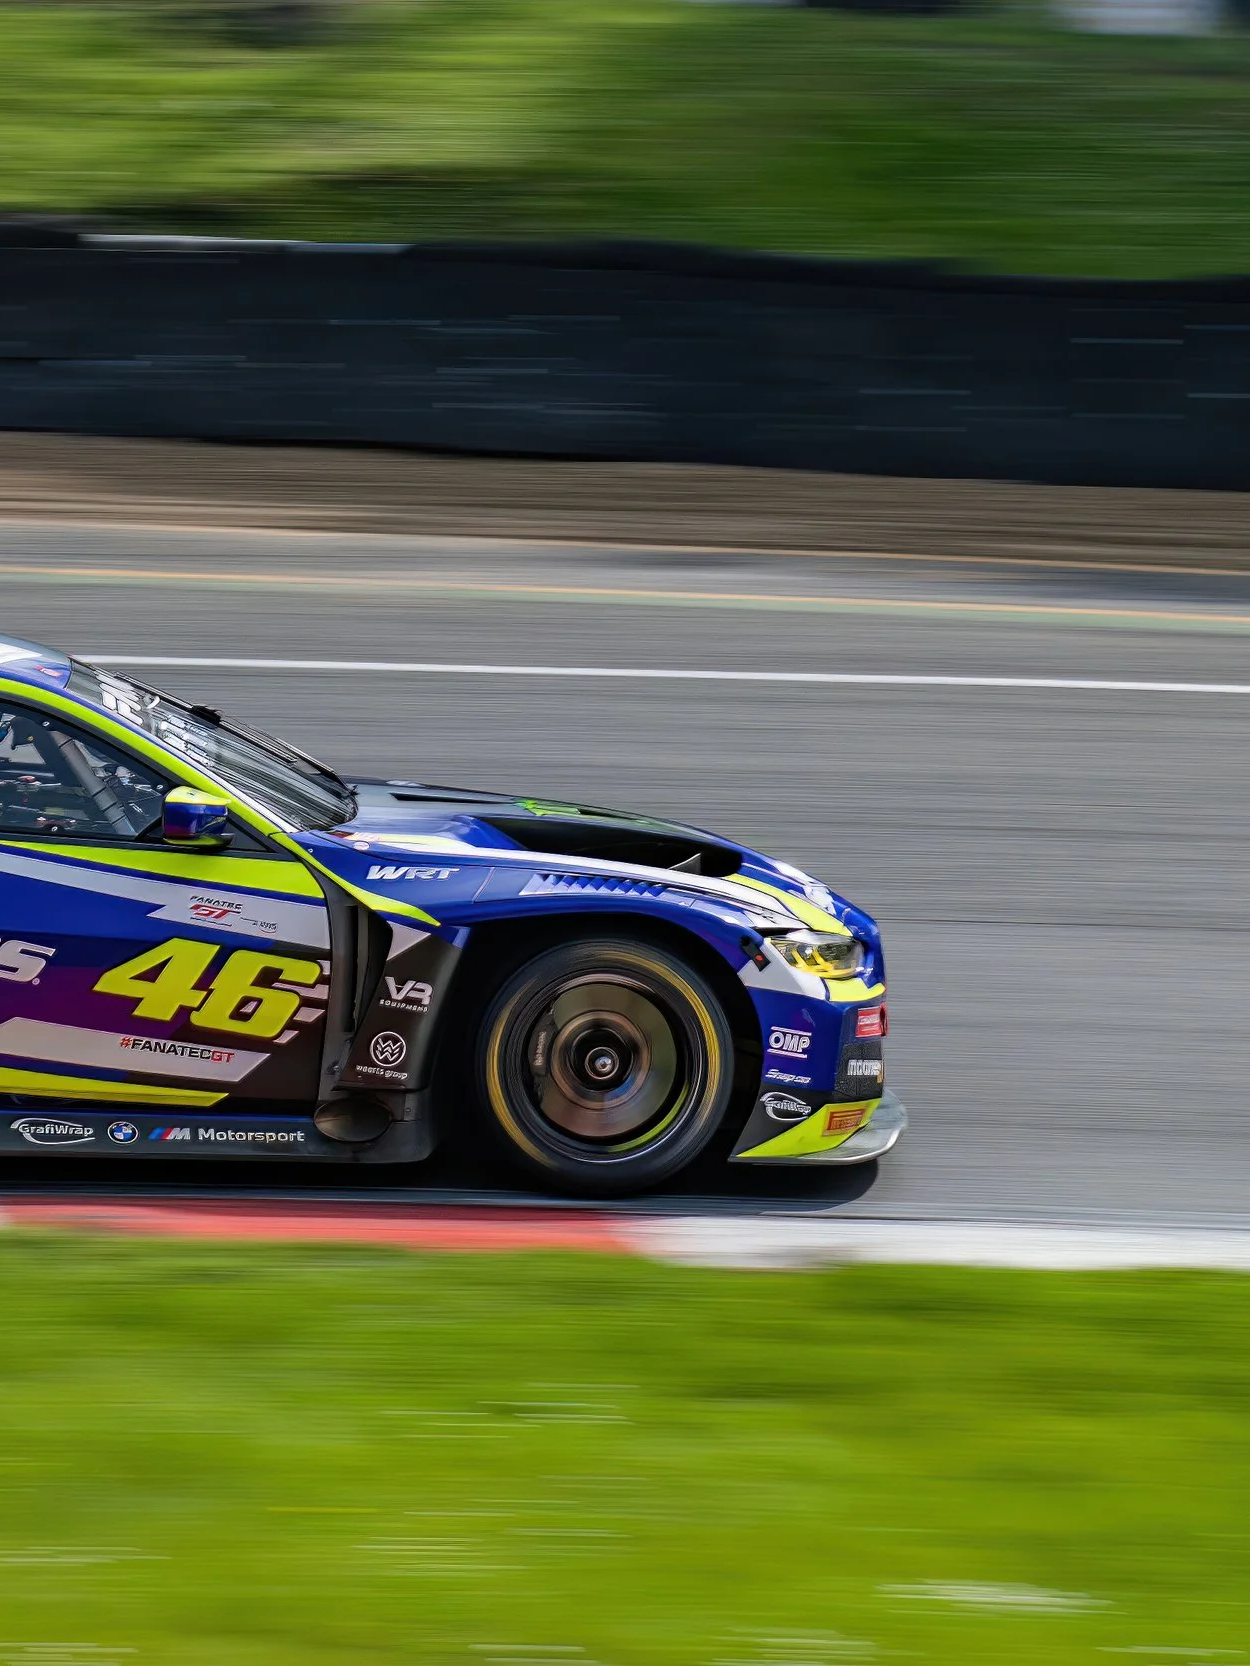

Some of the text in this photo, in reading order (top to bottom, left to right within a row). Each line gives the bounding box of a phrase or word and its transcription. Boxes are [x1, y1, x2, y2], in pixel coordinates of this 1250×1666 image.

[365, 865, 460, 880] WRT
[190, 895, 243, 910] FANATEC
[92, 937, 324, 1038] 46
[385, 976, 433, 1005] VR
[119, 1037, 235, 1064] #FANATECGT
[768, 1031, 811, 1053] OMP
[18, 1123, 94, 1137] GrafiWrap
[198, 1128, 305, 1144] Motorsport
